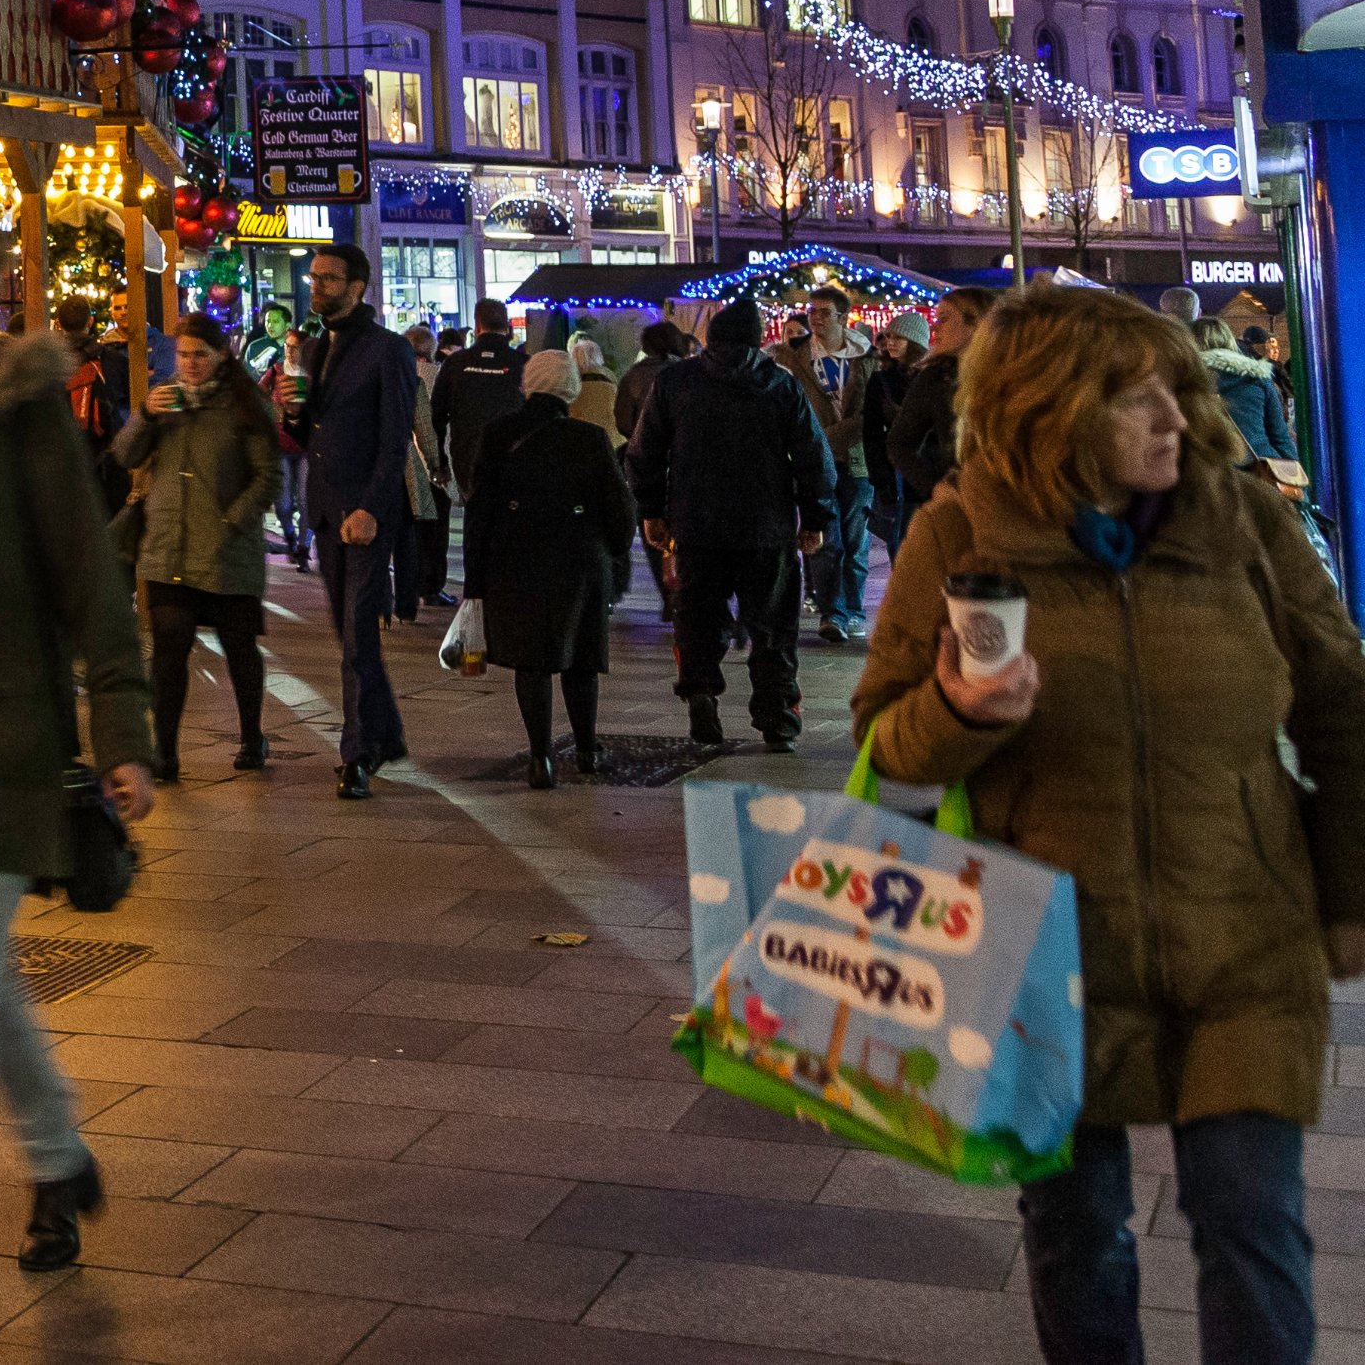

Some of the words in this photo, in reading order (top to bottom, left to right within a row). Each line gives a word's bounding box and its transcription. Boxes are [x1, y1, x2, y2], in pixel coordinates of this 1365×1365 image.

[286, 89, 330, 105] Cardiff
[259, 108, 305, 126] Festive
[308, 106, 359, 121] Quarter
[262, 131, 286, 145] Cold
[288, 130, 329, 144] German
[331, 128, 358, 143] Beer
[295, 165, 328, 178] Merry
[287, 182, 337, 193] Christmas
[286, 204, 334, 239] HILL
[1191, 261, 1255, 283] BURGER
[1259, 262, 1285, 283] KIN
